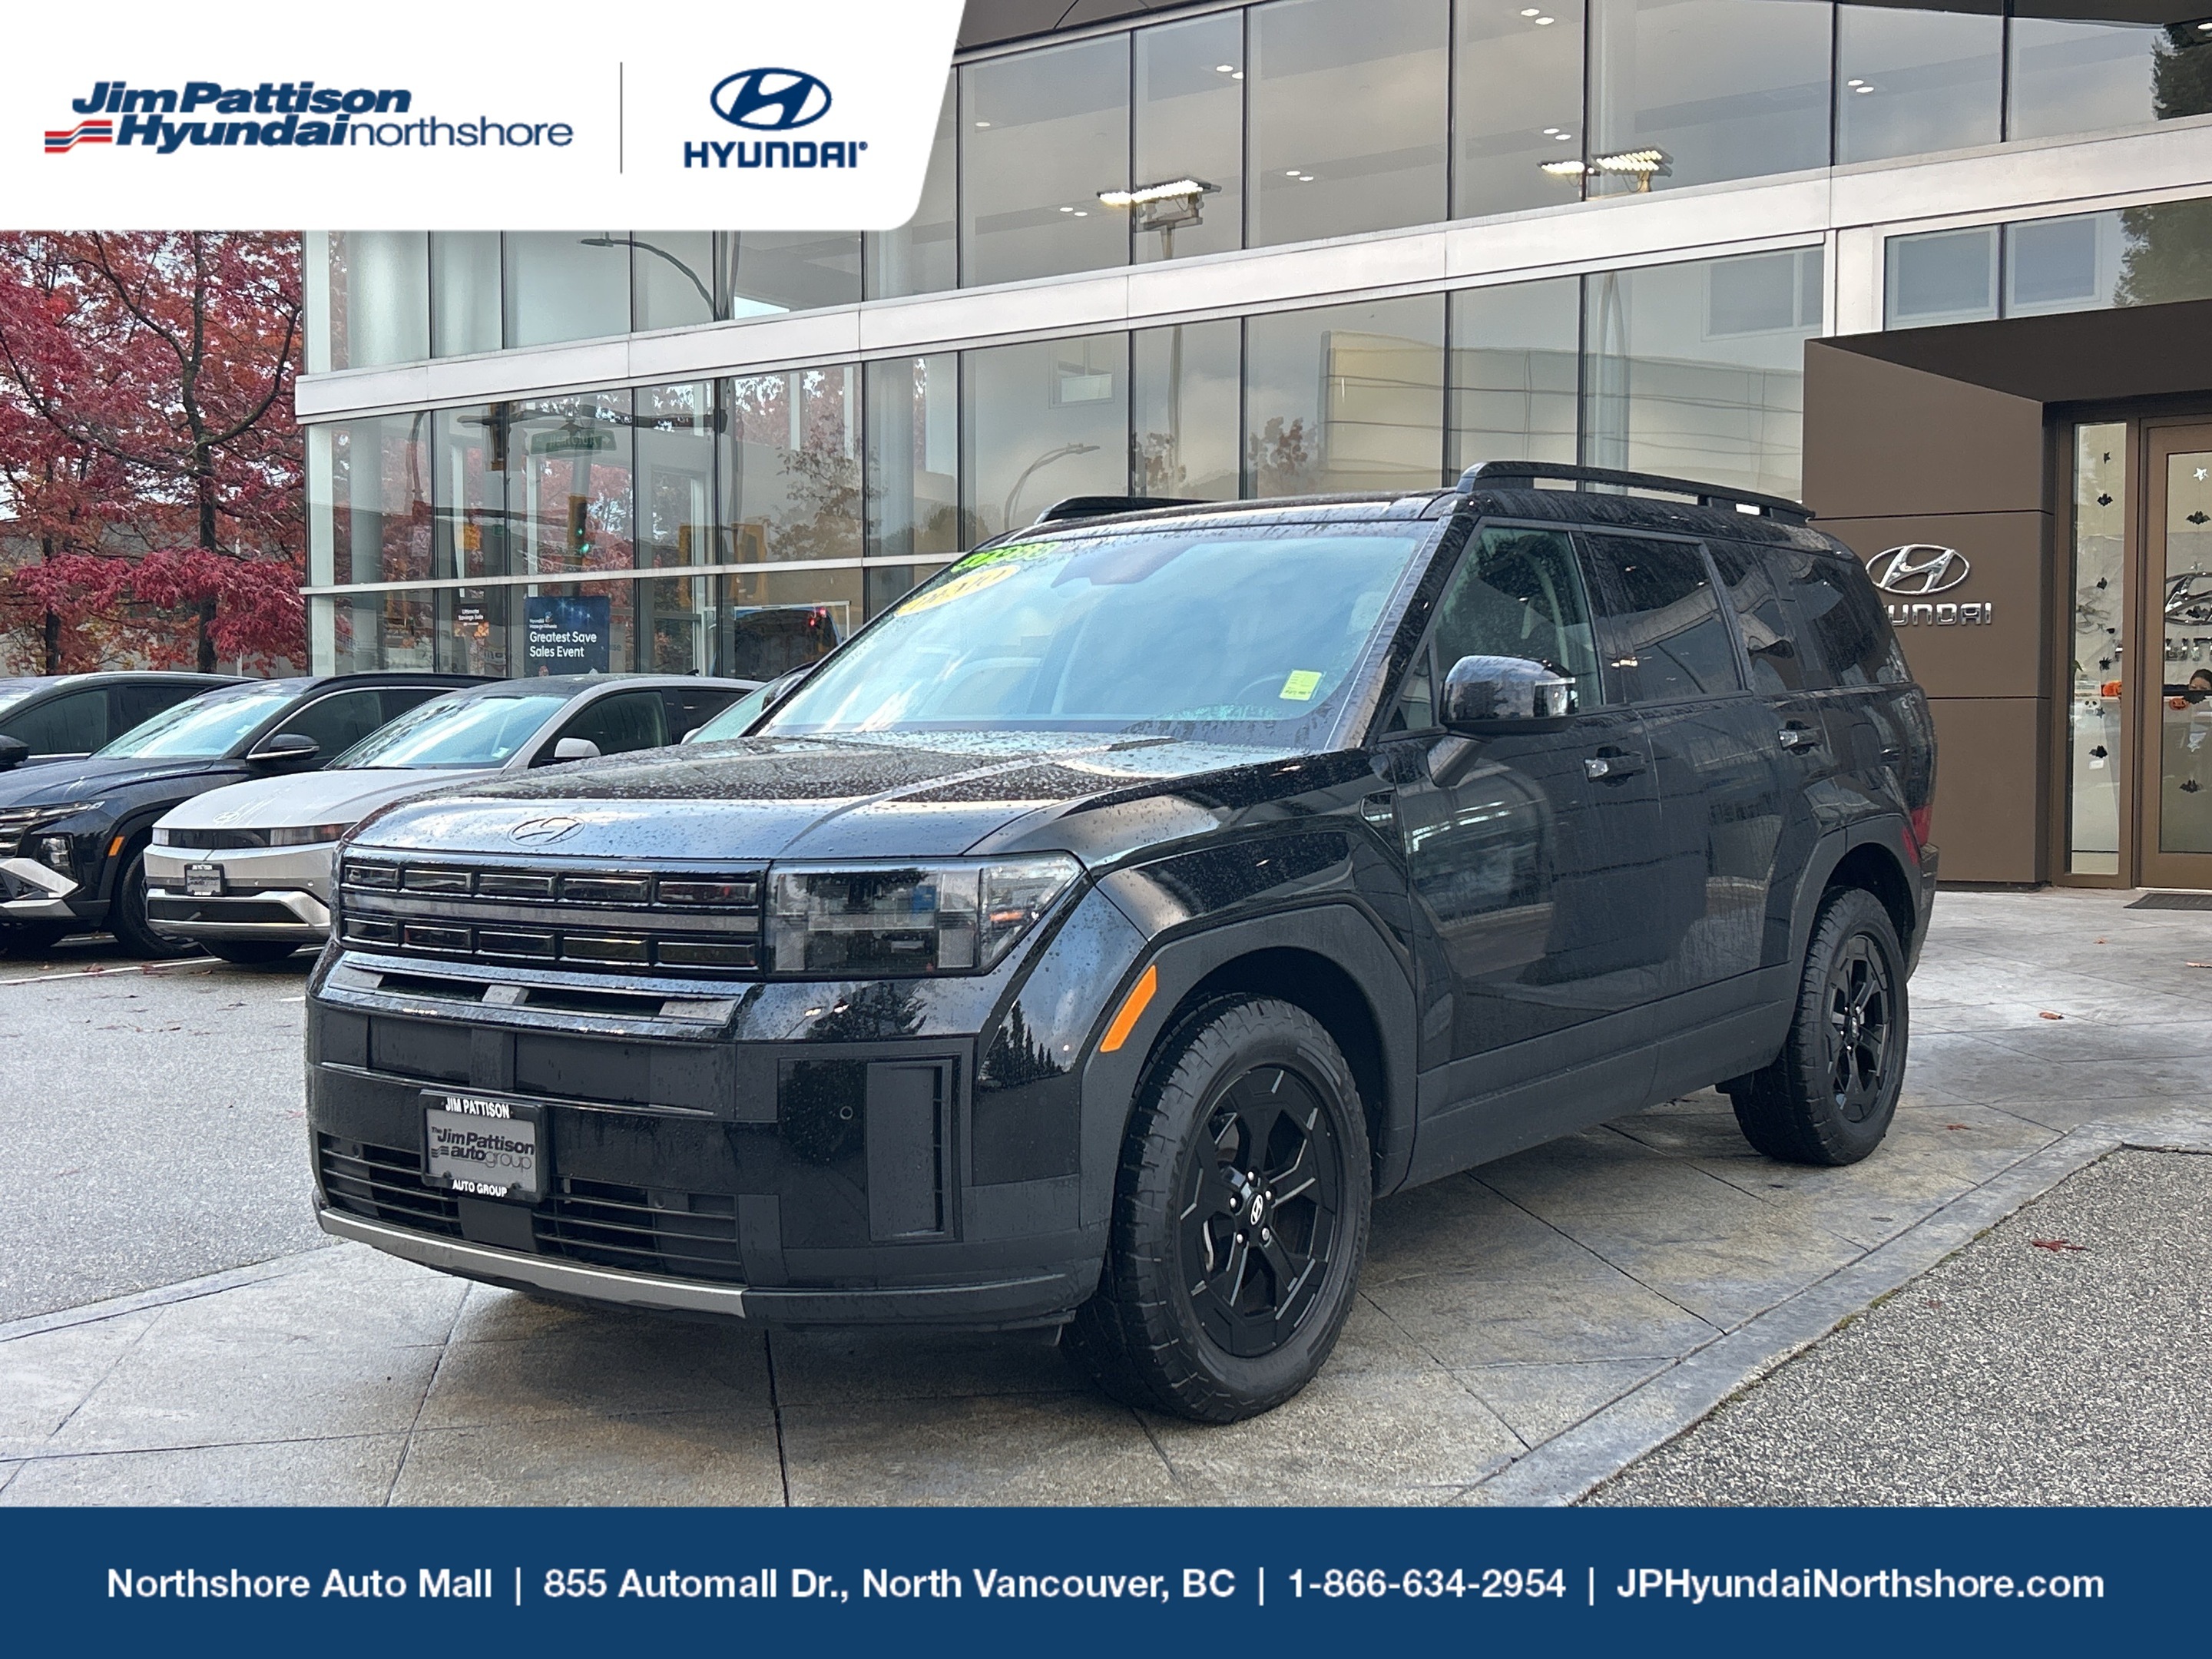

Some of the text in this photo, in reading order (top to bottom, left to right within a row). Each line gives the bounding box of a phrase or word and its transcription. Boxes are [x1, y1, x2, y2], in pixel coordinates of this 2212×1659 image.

[1883, 602, 1992, 627] UNDAI
[529, 631, 597, 643] Greatest Save
[529, 645, 584, 657] Sales Event
[445, 1097, 510, 1119] JIM PATTISON
[452, 1179, 508, 1197] AUTO GROUP
